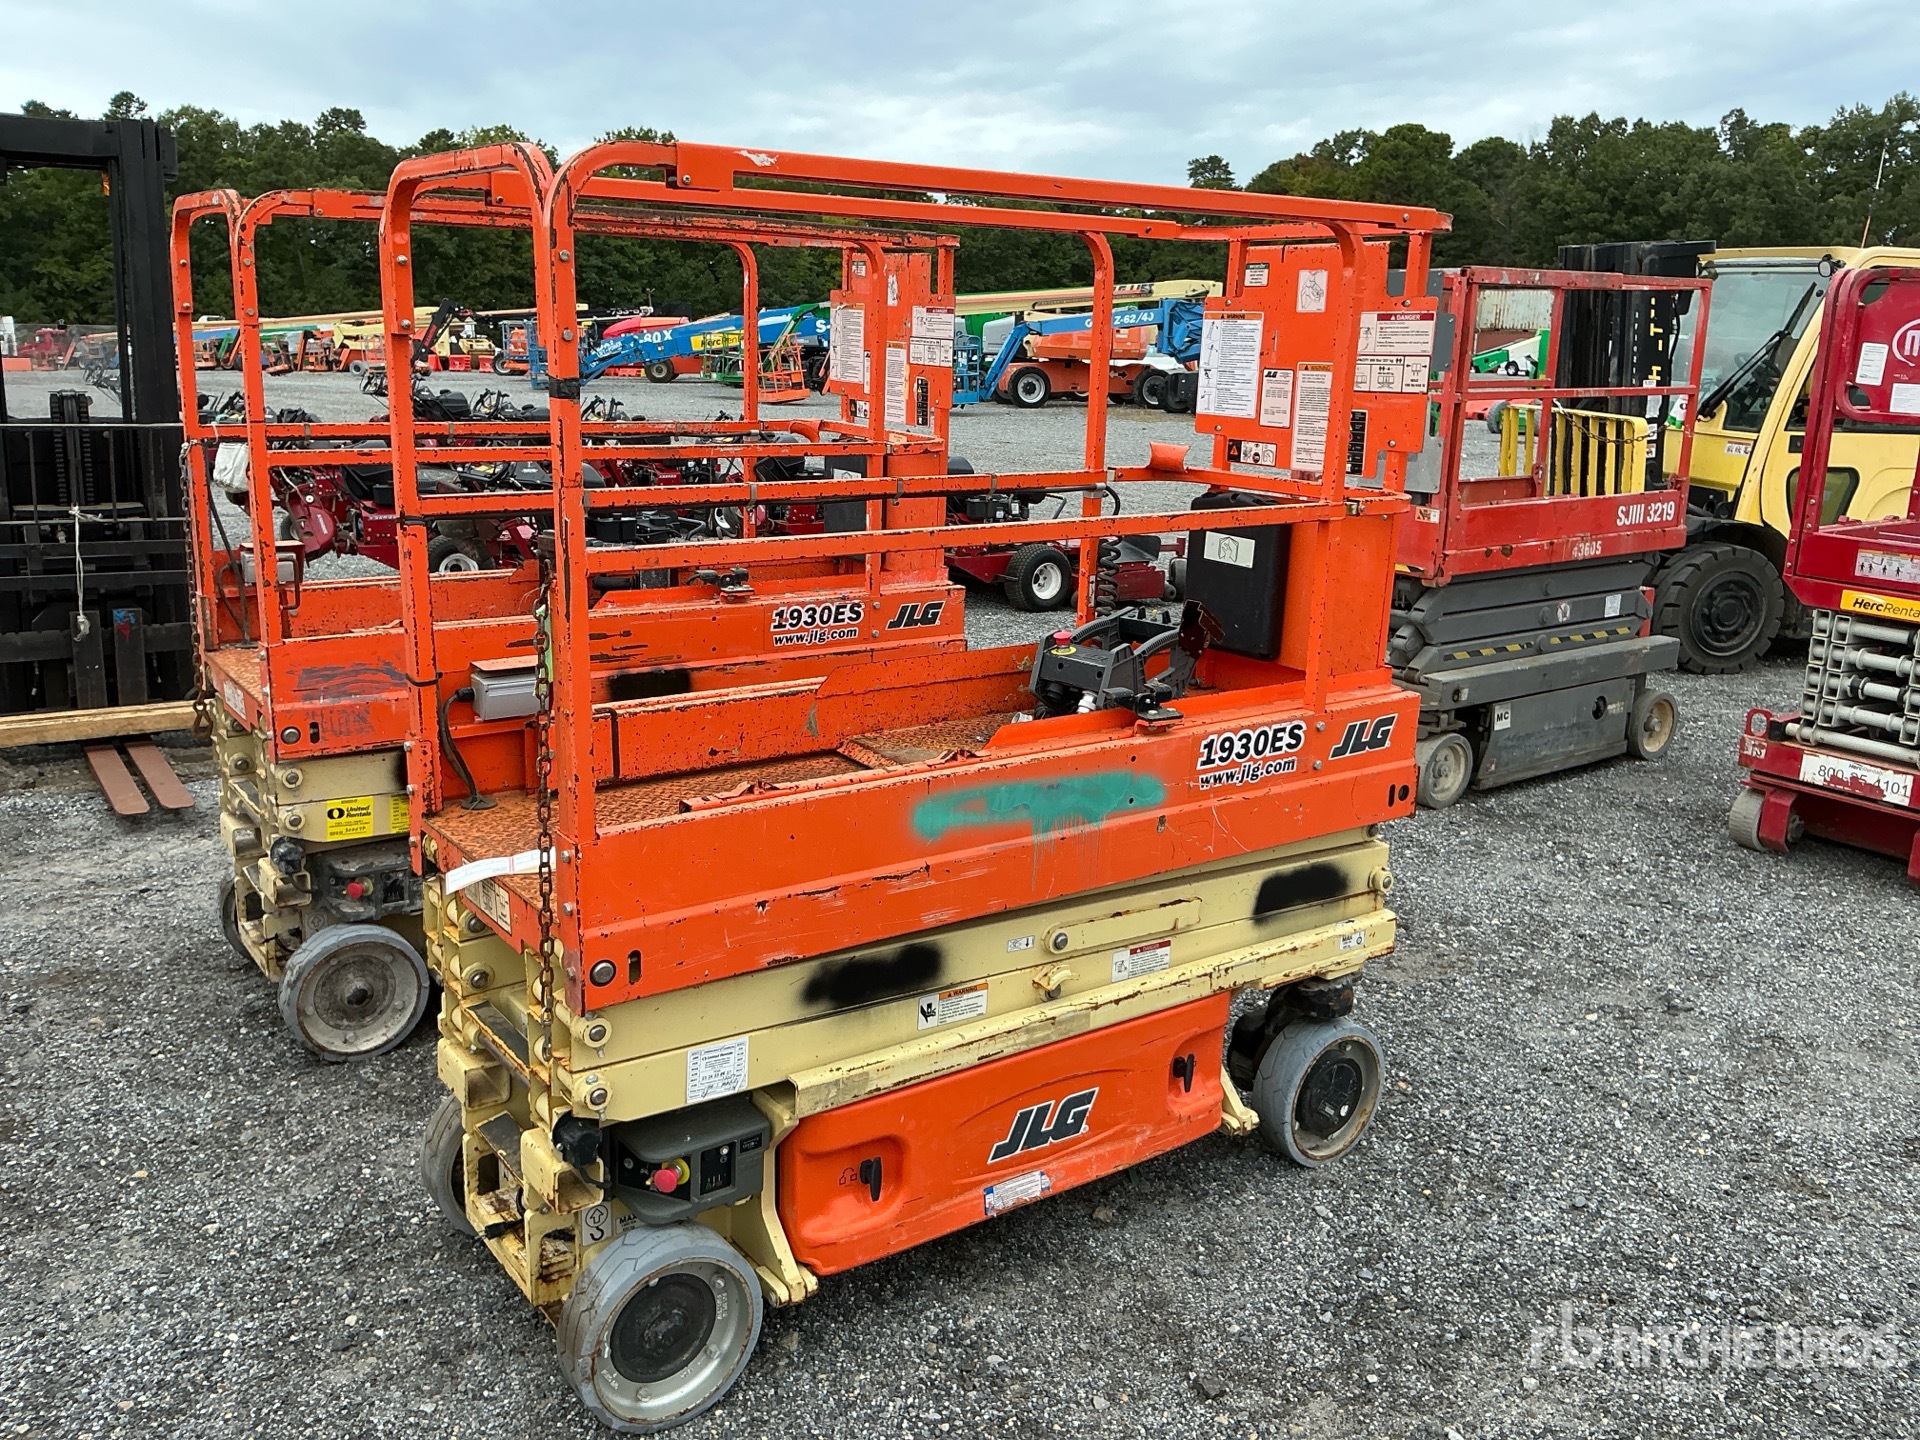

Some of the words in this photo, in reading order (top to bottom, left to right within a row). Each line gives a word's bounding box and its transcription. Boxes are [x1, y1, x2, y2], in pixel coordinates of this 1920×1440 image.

[1647, 501, 1676, 523] 3219
[772, 602, 864, 631] 1930ES
[886, 600, 945, 630] JLG
[773, 629, 858, 645] www.jlg.com
[1496, 711, 1510, 722] MC
[1199, 723, 1305, 768] 1930ES
[1329, 714, 1398, 760] JLG
[1200, 759, 1296, 789] www.jlg.com
[346, 811, 371, 819] Rentals
[953, 985, 978, 996] WARNING
[988, 1088, 1097, 1163] JLG
[620, 1213, 638, 1224] MAX
